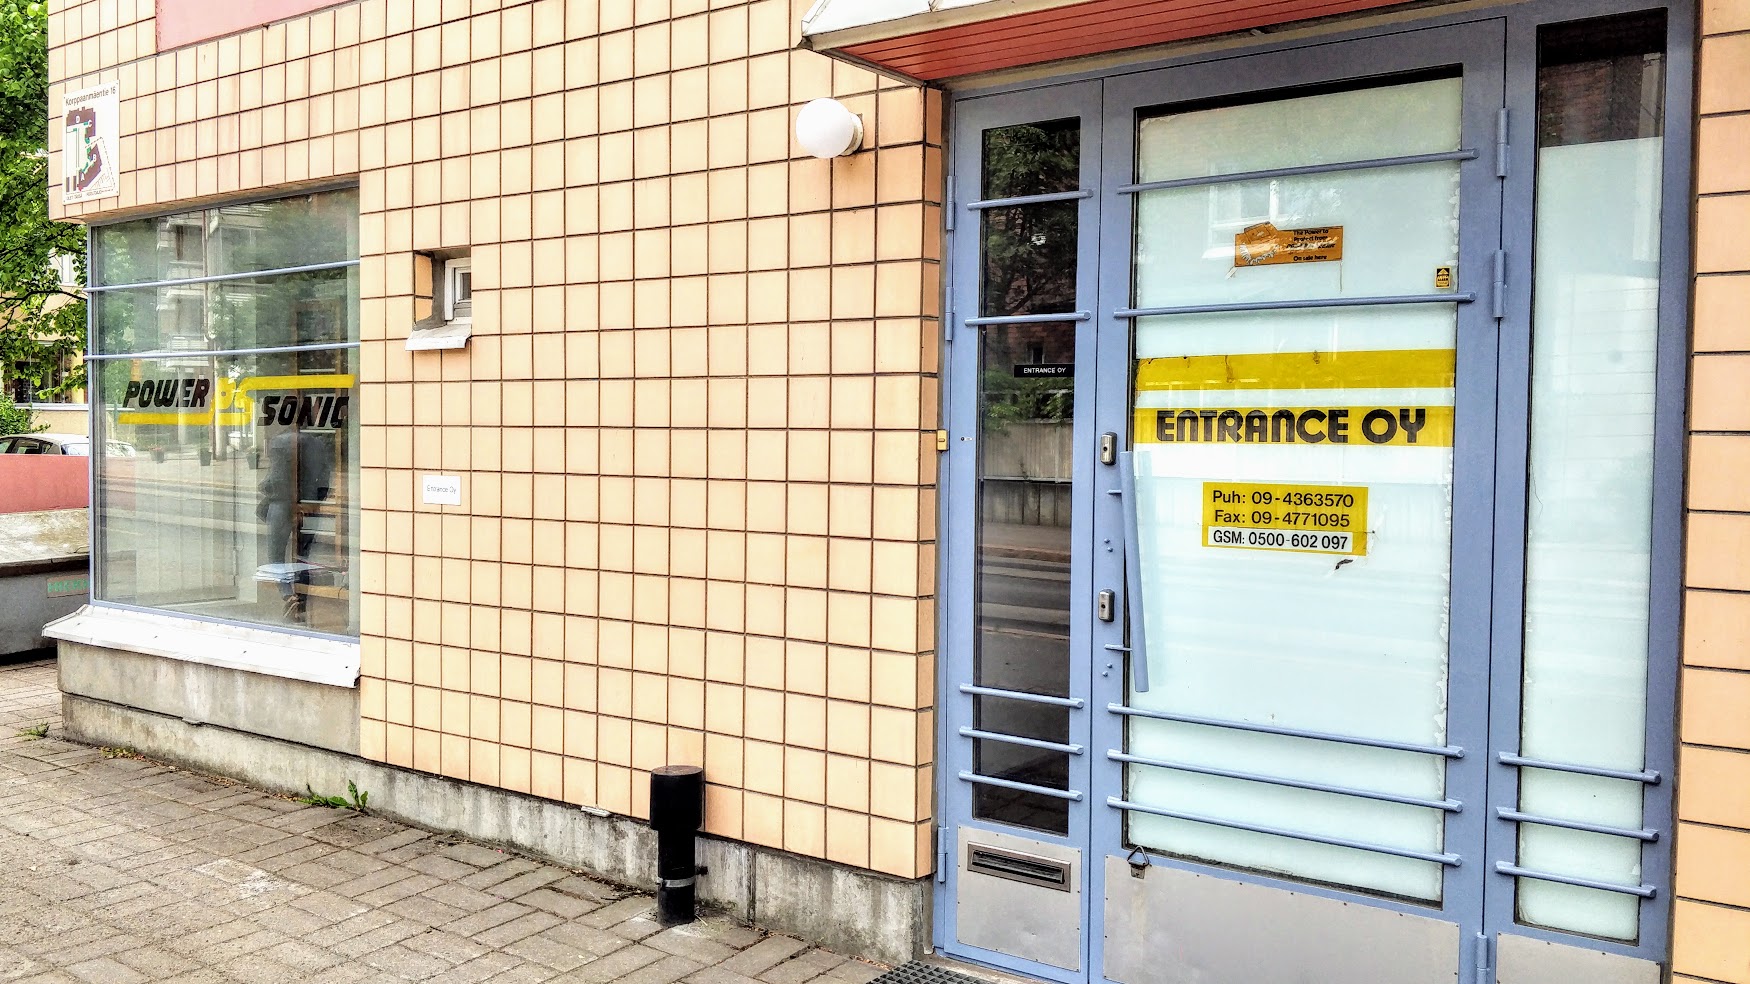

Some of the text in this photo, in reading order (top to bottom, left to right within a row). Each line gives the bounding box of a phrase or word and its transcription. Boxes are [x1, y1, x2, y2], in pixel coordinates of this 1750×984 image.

[122, 378, 211, 408] POWER
[257, 396, 350, 429] SONIC
[1156, 408, 1426, 444] ENTRANCE OY
[1212, 490, 1246, 504] Puh:
[1214, 510, 1246, 523] Fax:
[1213, 530, 1348, 549] GSM: 0500-602 097
